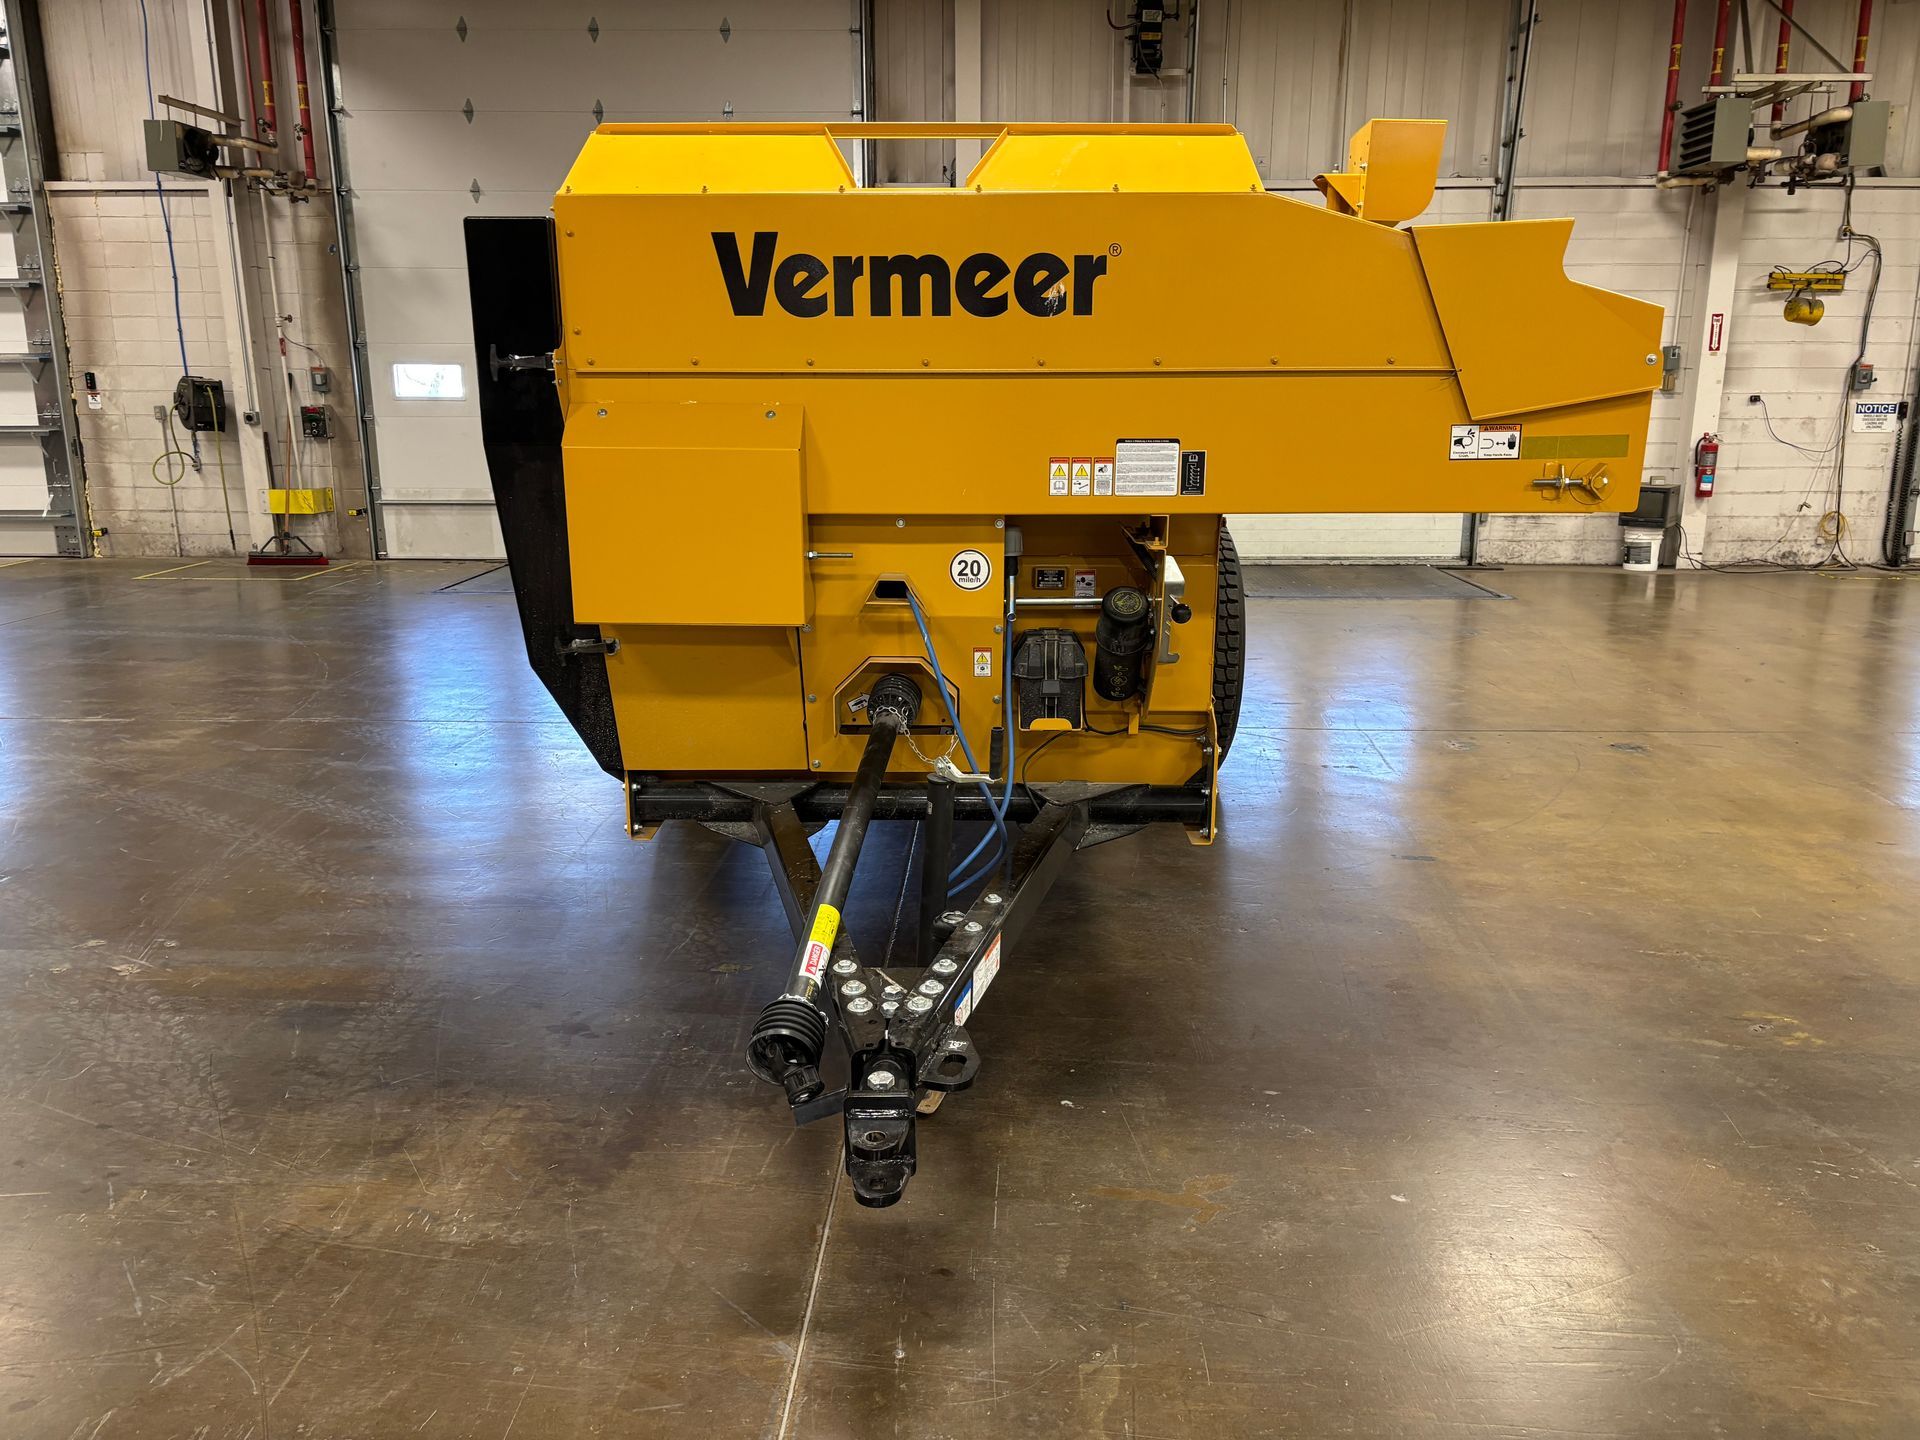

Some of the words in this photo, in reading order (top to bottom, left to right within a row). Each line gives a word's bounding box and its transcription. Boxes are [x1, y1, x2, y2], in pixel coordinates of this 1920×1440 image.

[711, 232, 1107, 318] Vermeer
[1857, 404, 1895, 413] NOTICE
[957, 559, 981, 577] 20
[809, 945, 821, 967] DANGER
